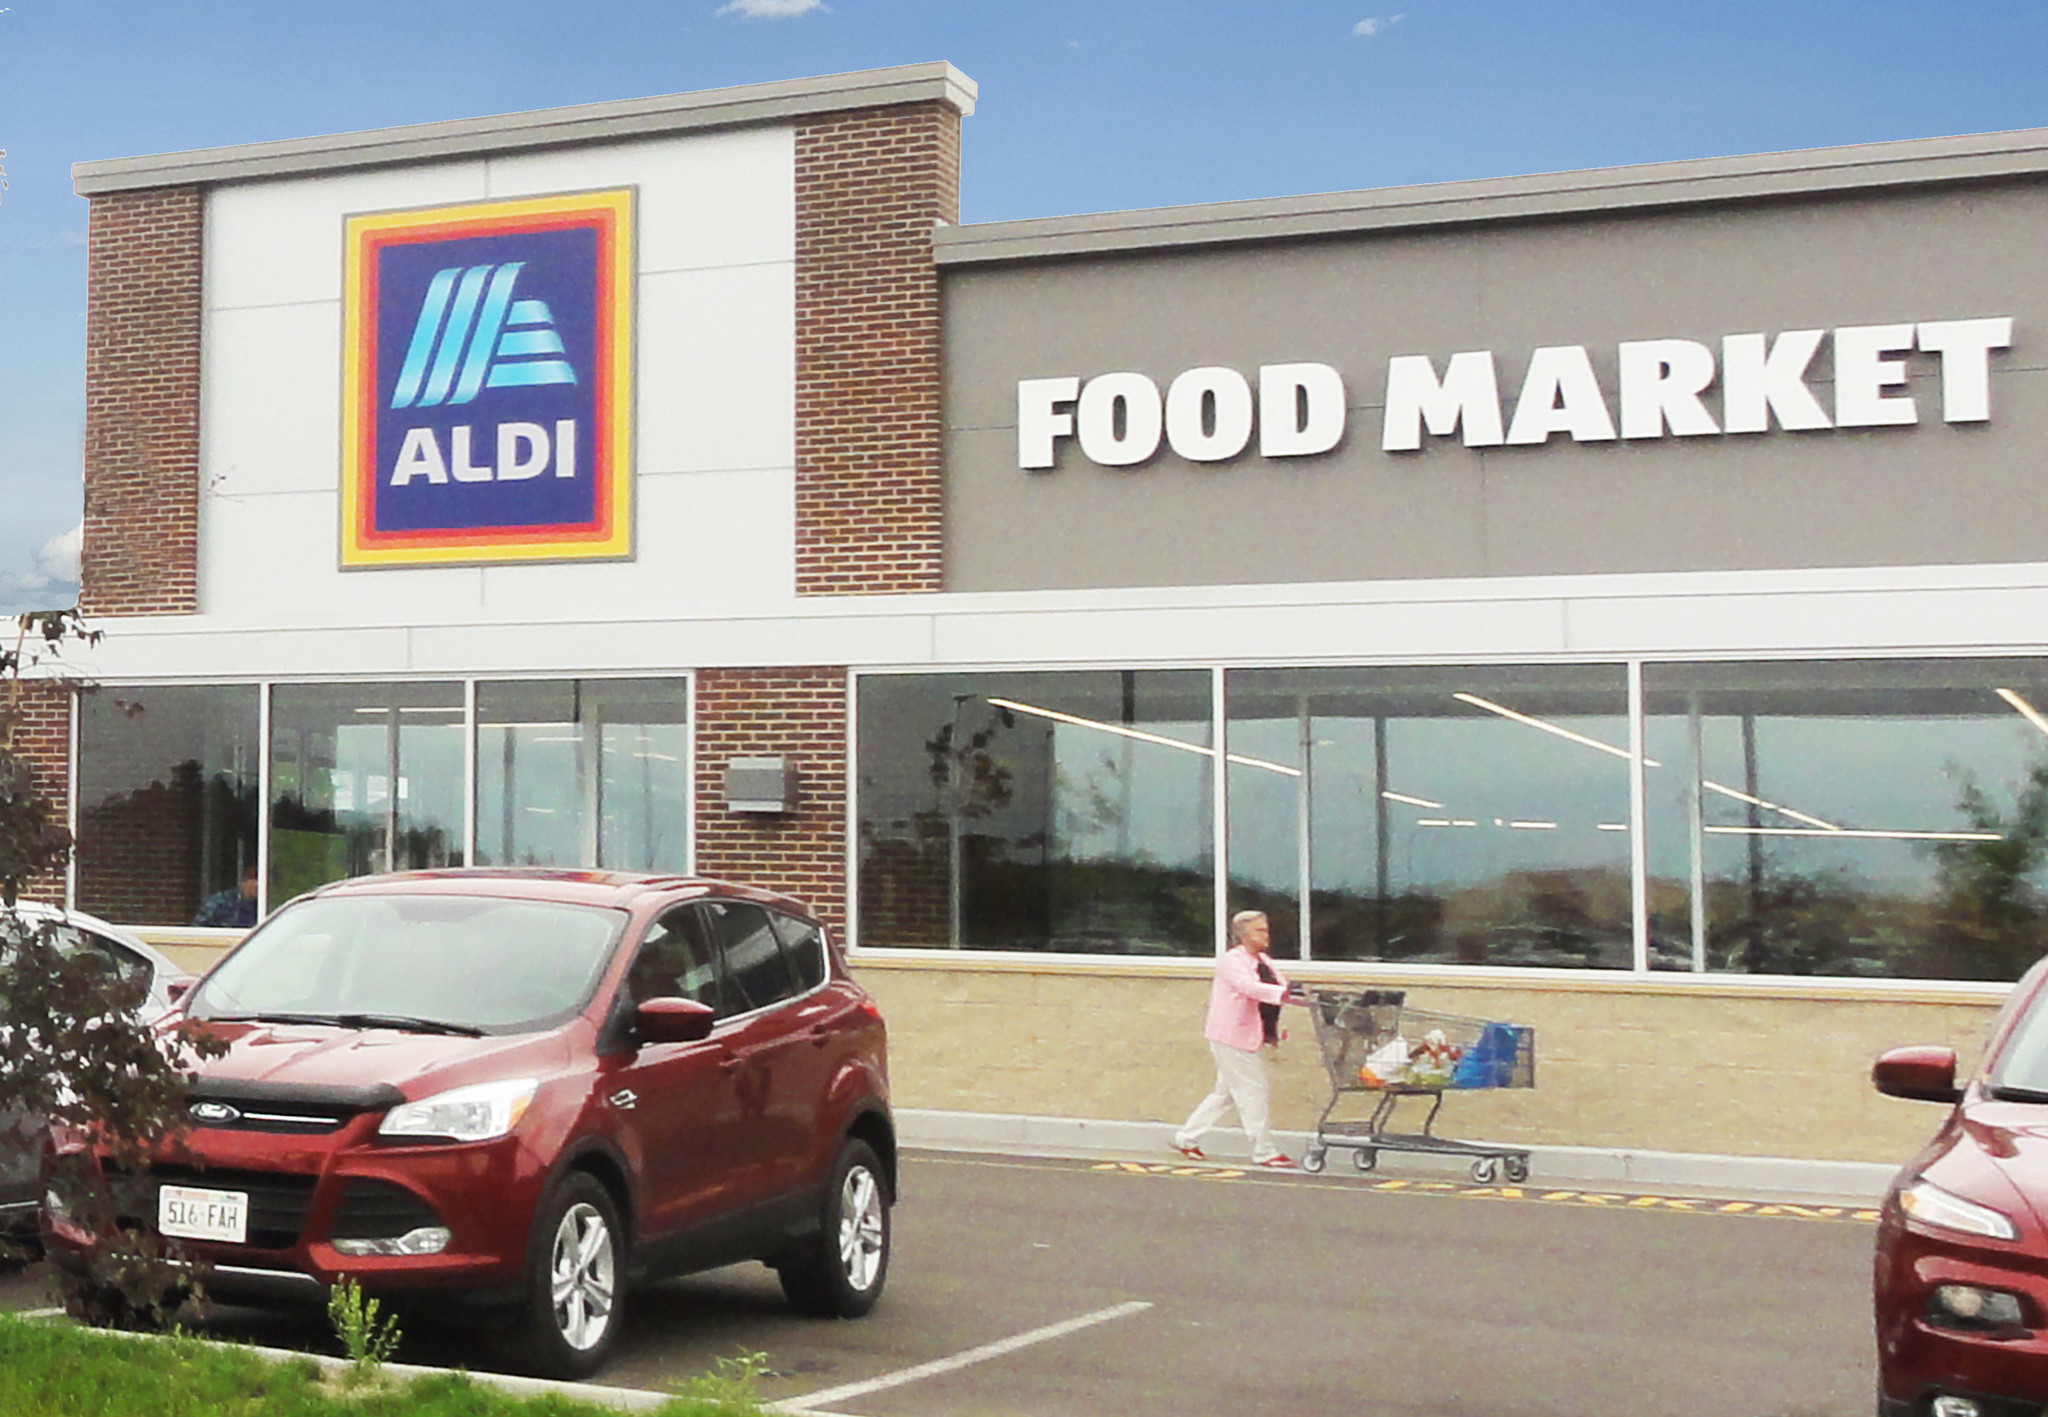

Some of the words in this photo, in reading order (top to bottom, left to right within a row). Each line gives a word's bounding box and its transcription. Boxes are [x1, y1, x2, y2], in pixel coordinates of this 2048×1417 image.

[1017, 362, 1346, 469] FOOD
[1381, 317, 2013, 452] MARKET
[389, 419, 577, 487] ALDI
